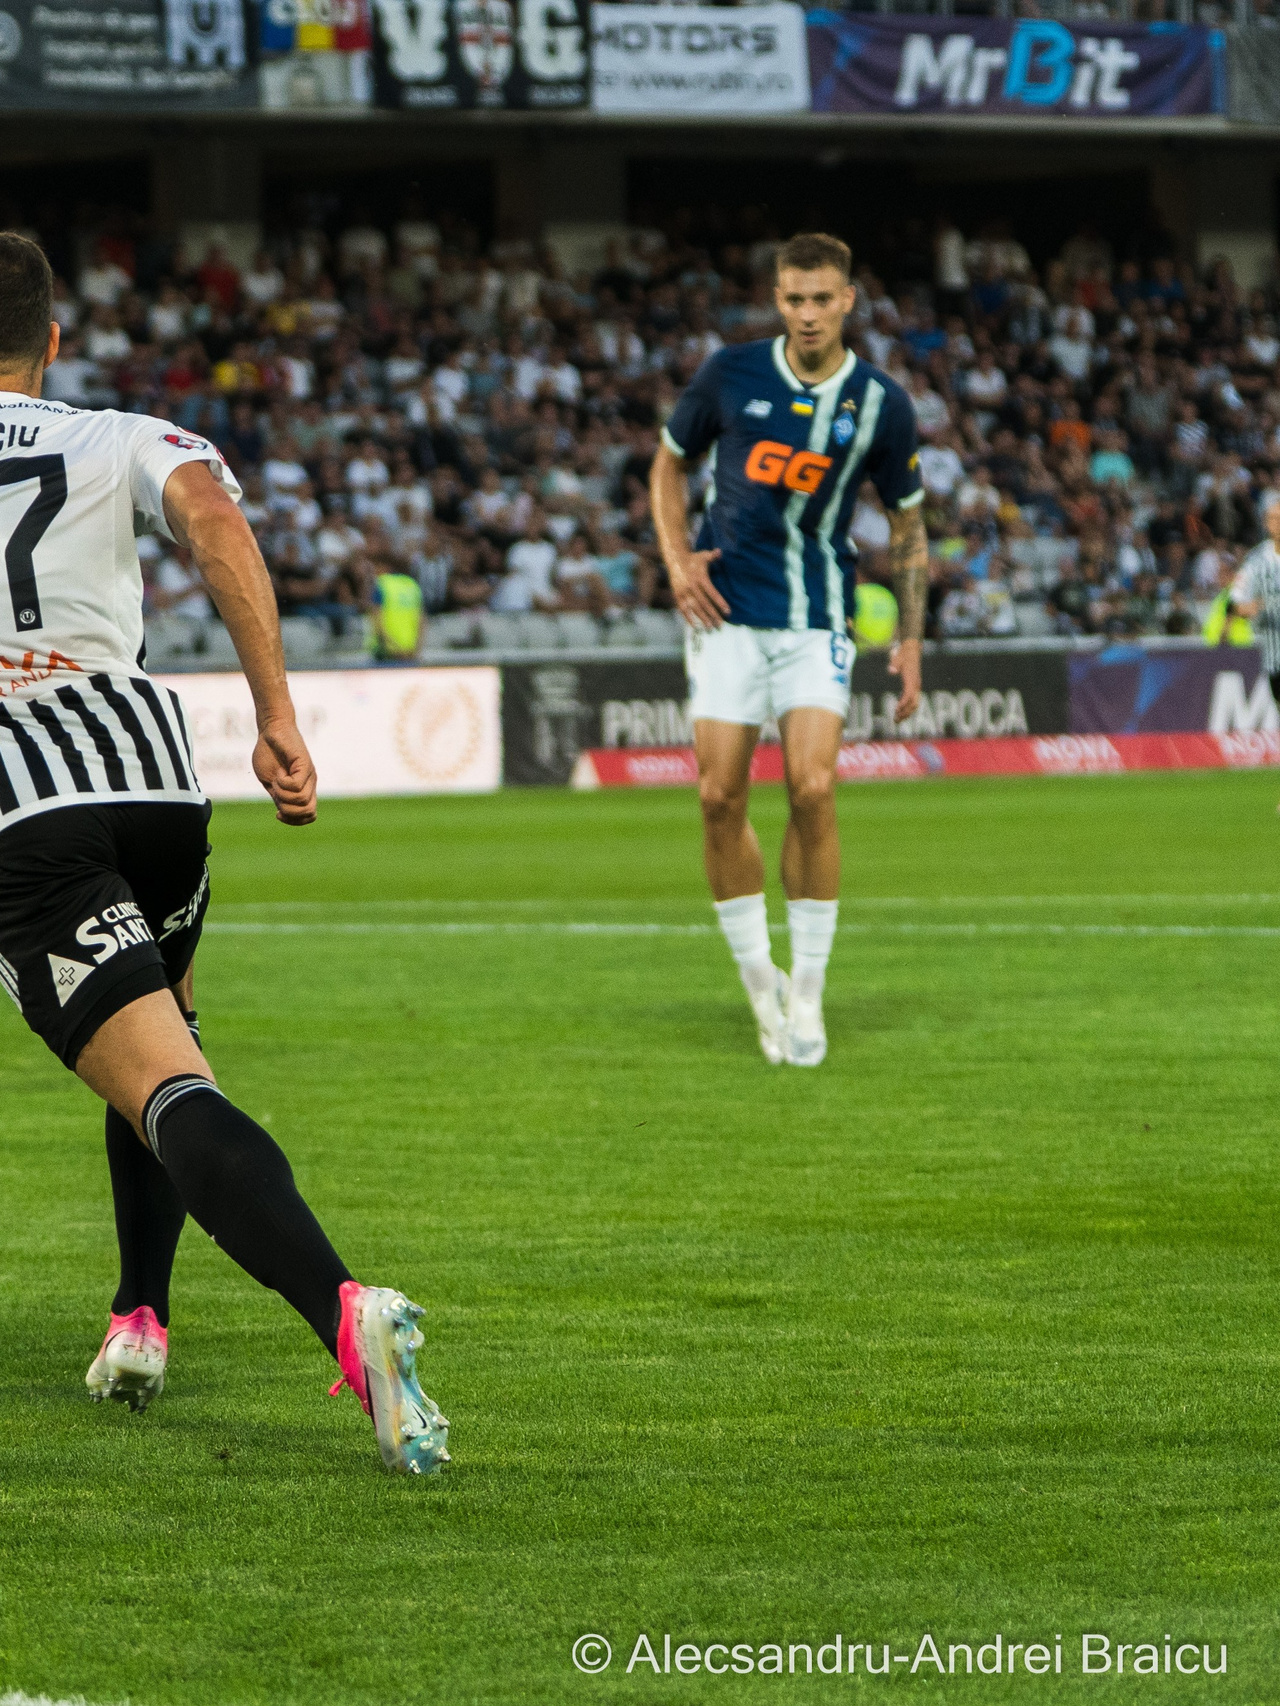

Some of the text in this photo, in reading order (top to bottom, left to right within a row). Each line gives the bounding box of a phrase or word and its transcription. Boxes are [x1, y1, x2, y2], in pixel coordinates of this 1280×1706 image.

[894, 18, 1141, 106] MrBit
[744, 440, 834, 495] GG
[101, 901, 144, 923] CLINIC
[75, 915, 155, 965] SANT
